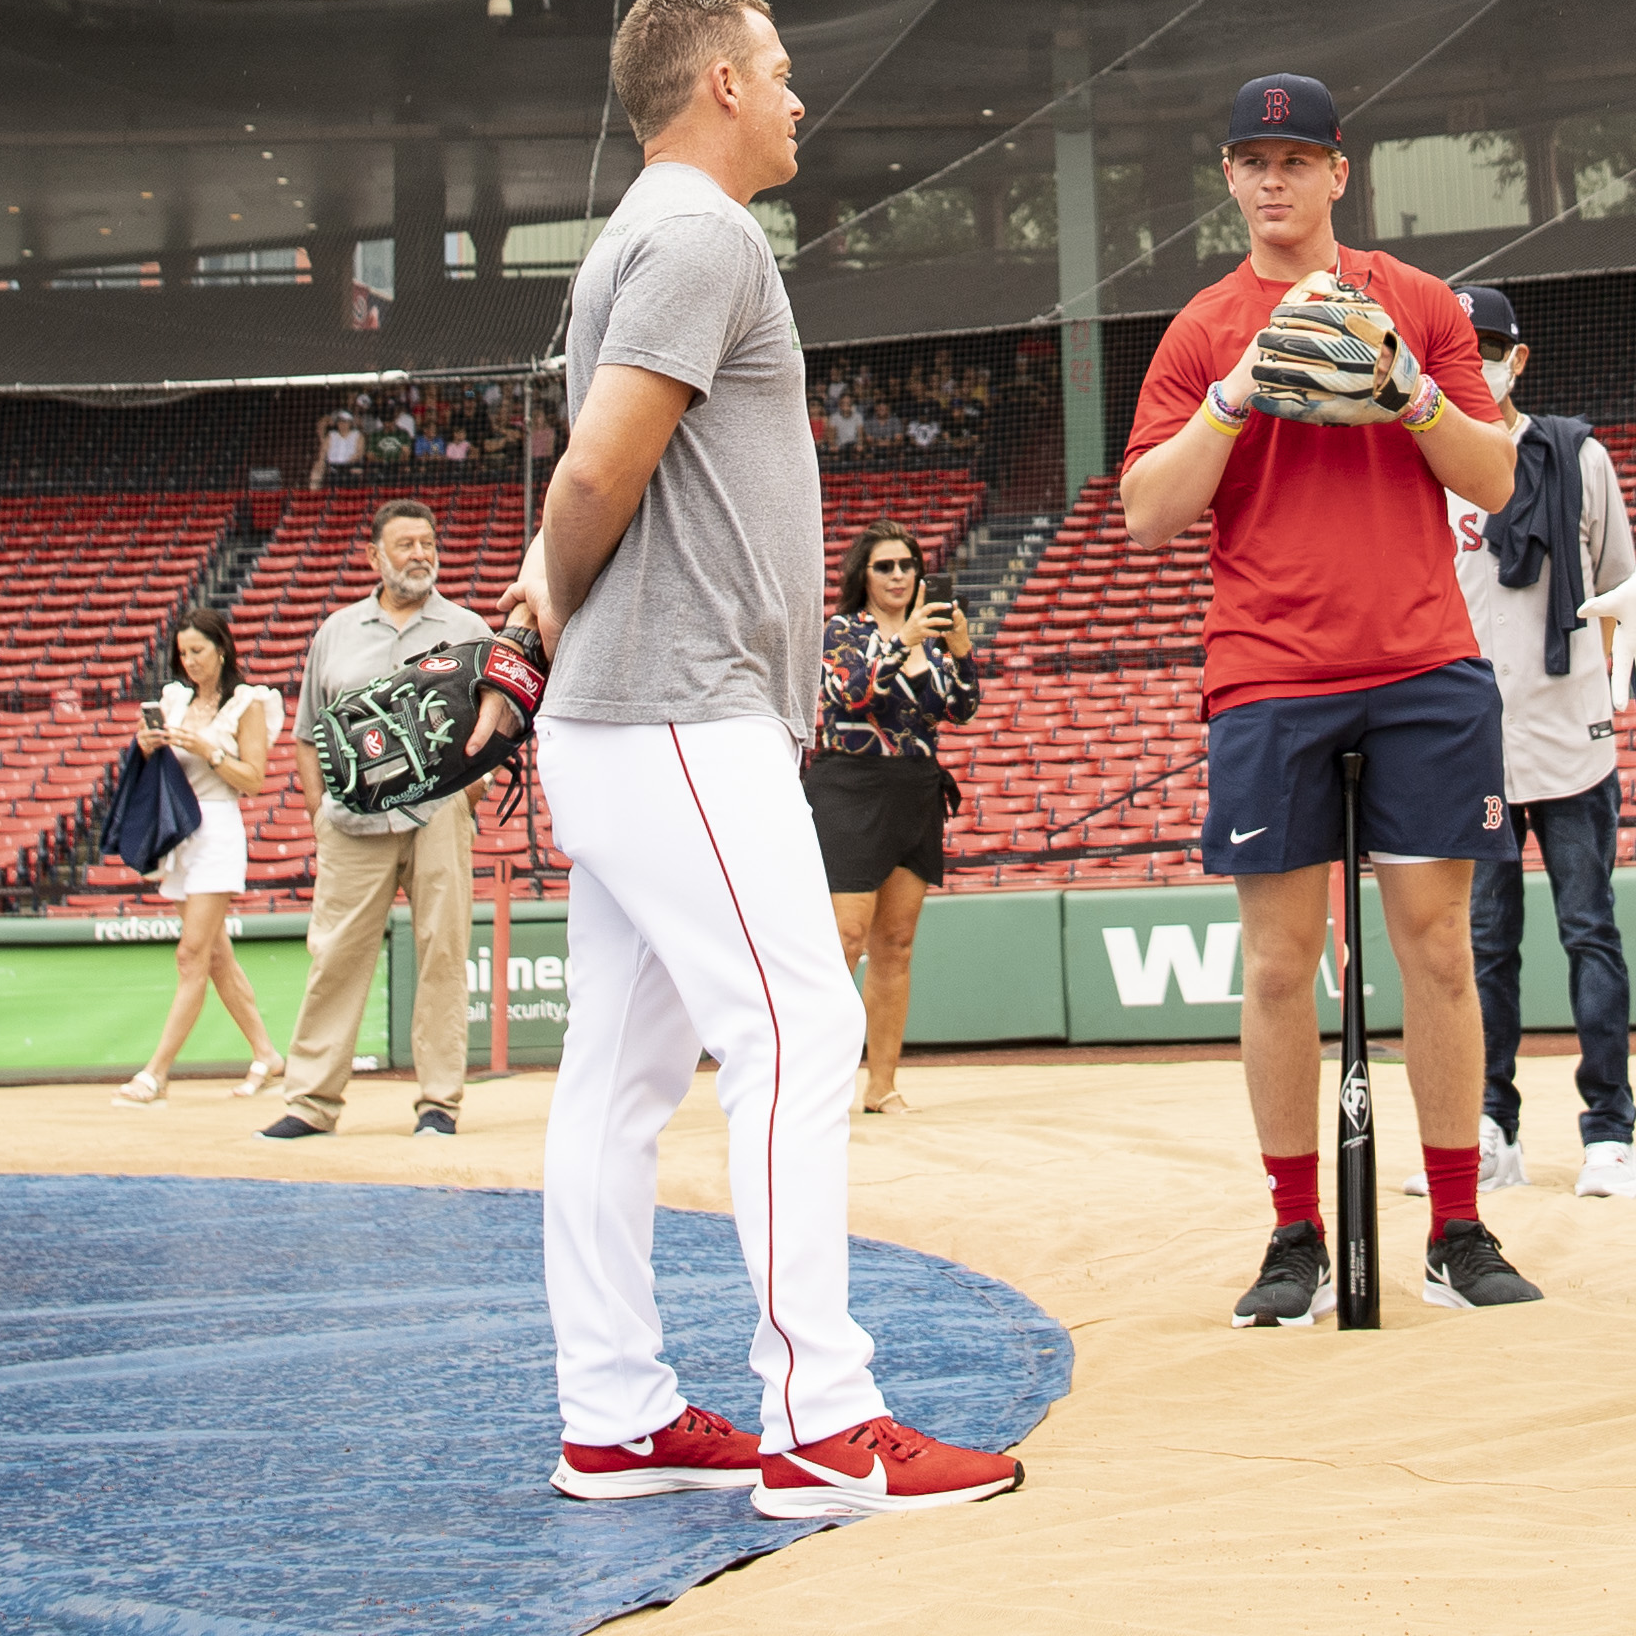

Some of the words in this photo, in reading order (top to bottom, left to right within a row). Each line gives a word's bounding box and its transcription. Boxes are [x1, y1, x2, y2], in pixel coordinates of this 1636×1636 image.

[1262, 88, 1291, 125] B
[380, 773, 441, 810] Rawlings
[1482, 794, 1504, 830] B
